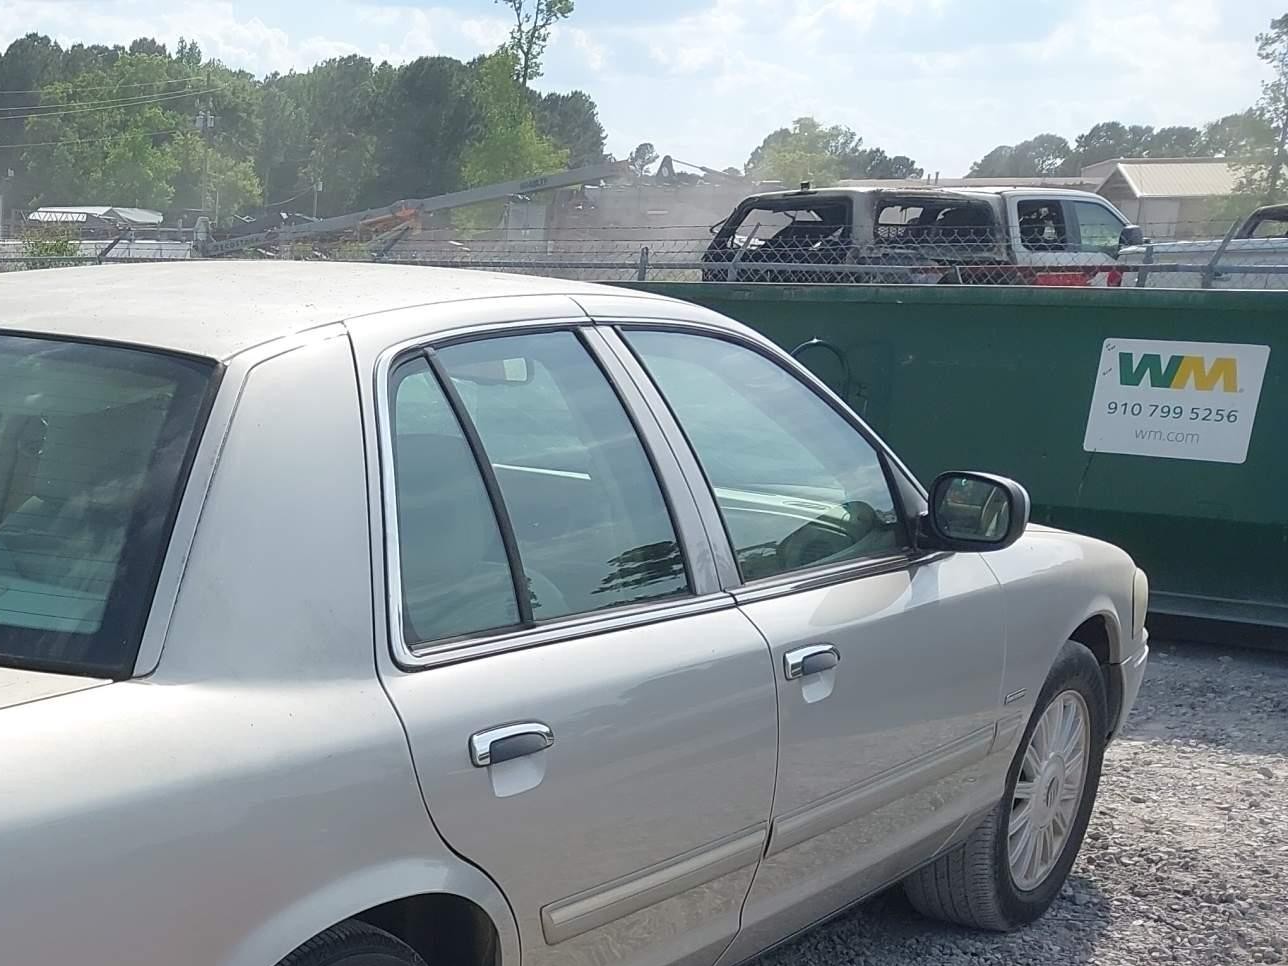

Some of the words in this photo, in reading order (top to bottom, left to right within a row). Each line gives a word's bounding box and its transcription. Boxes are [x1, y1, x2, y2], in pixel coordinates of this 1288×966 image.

[1119, 352, 1238, 393] WM
[1107, 401, 1143, 417] 910
[1148, 404, 1184, 420] 799
[1189, 407, 1239, 423] 5256
[1135, 428, 1200, 445] wm.com
